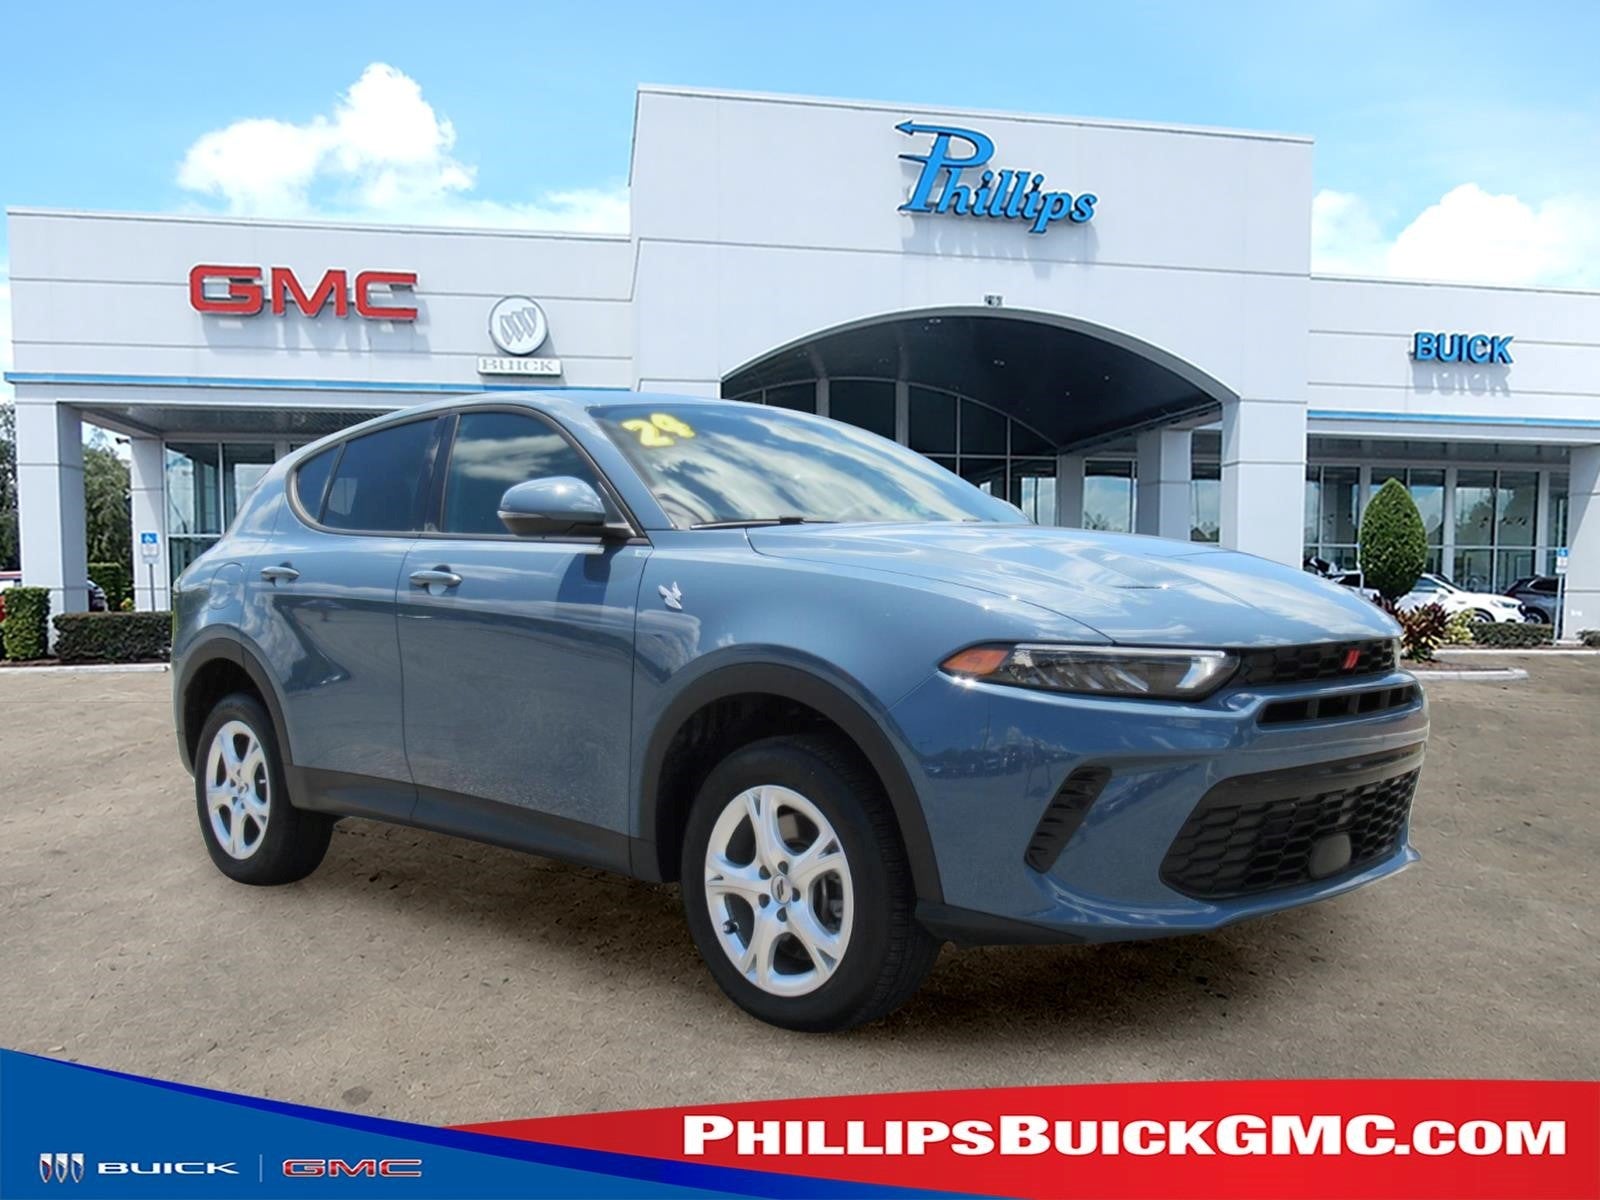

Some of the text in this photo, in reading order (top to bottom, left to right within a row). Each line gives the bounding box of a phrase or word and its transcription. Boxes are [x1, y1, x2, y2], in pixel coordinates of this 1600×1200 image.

[894, 120, 1098, 234] Phillips
[189, 264, 418, 321] GMC
[482, 358, 554, 372] BUICK
[1413, 331, 1514, 364] BUICK
